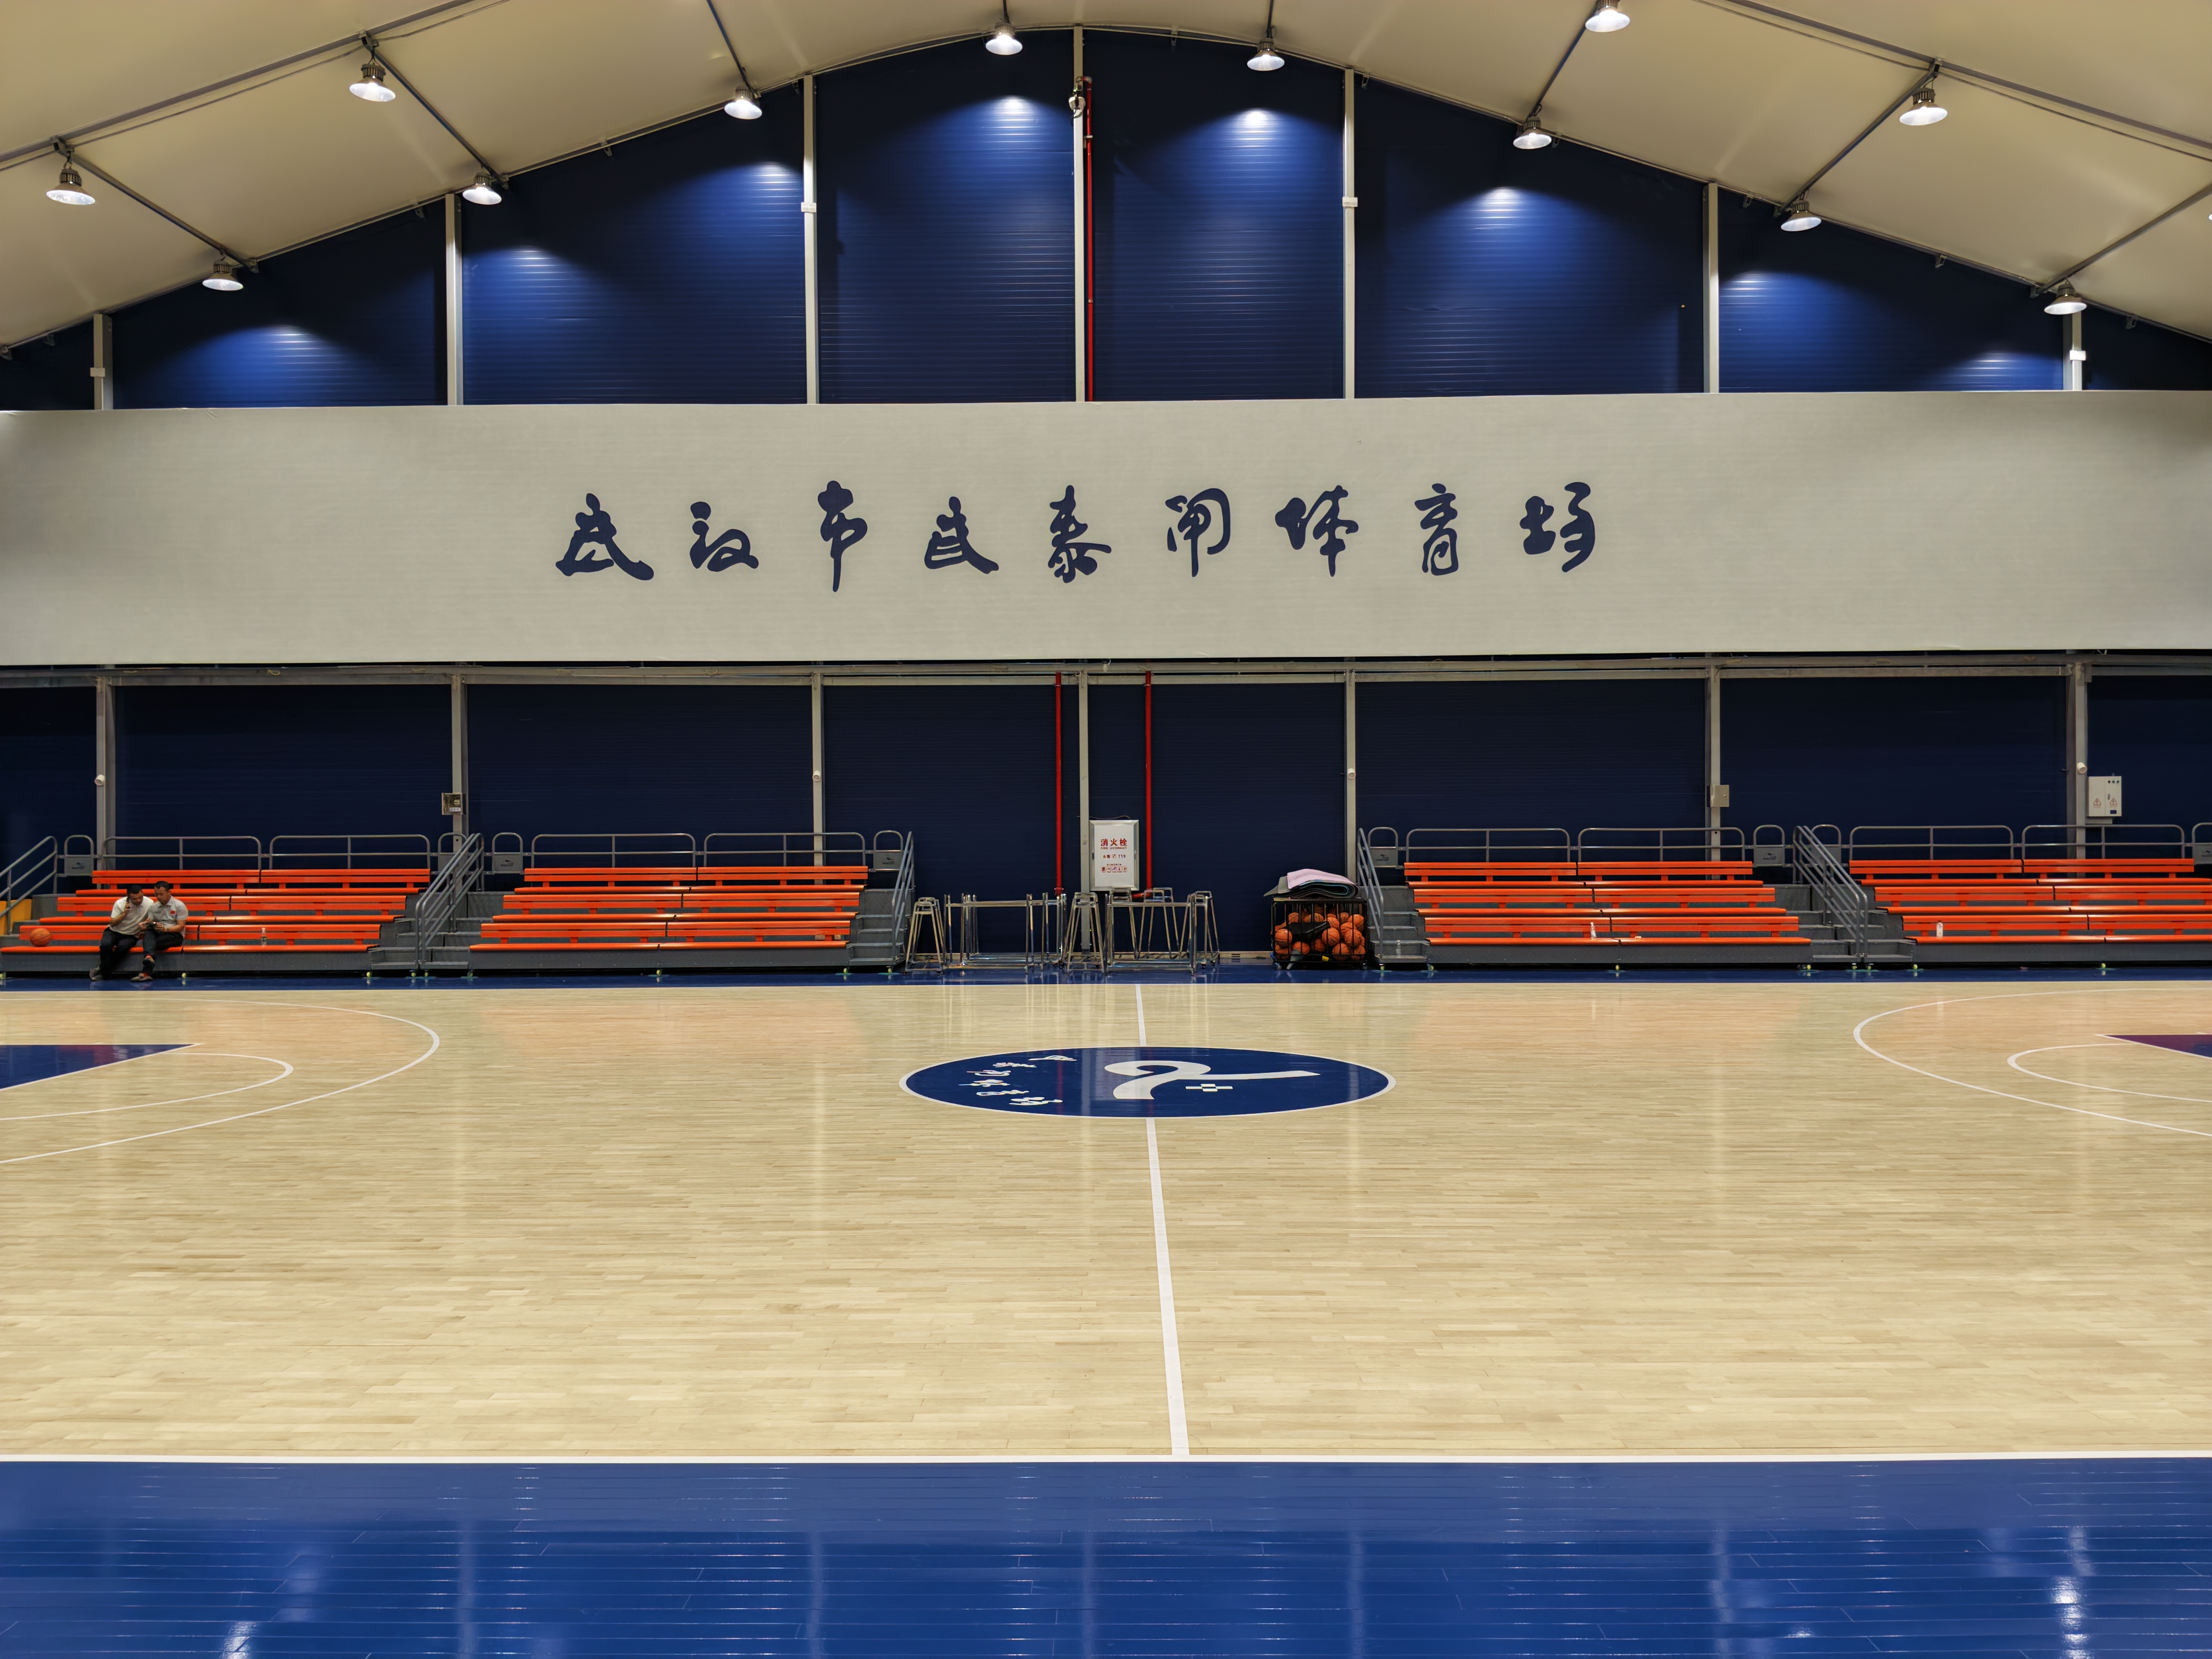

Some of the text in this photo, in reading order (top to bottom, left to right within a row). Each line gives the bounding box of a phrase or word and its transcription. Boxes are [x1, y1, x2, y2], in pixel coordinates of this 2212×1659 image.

[555, 479, 1596, 592] 武汉市武泰闸体育场
[1100, 838, 1127, 846] 消火栓
